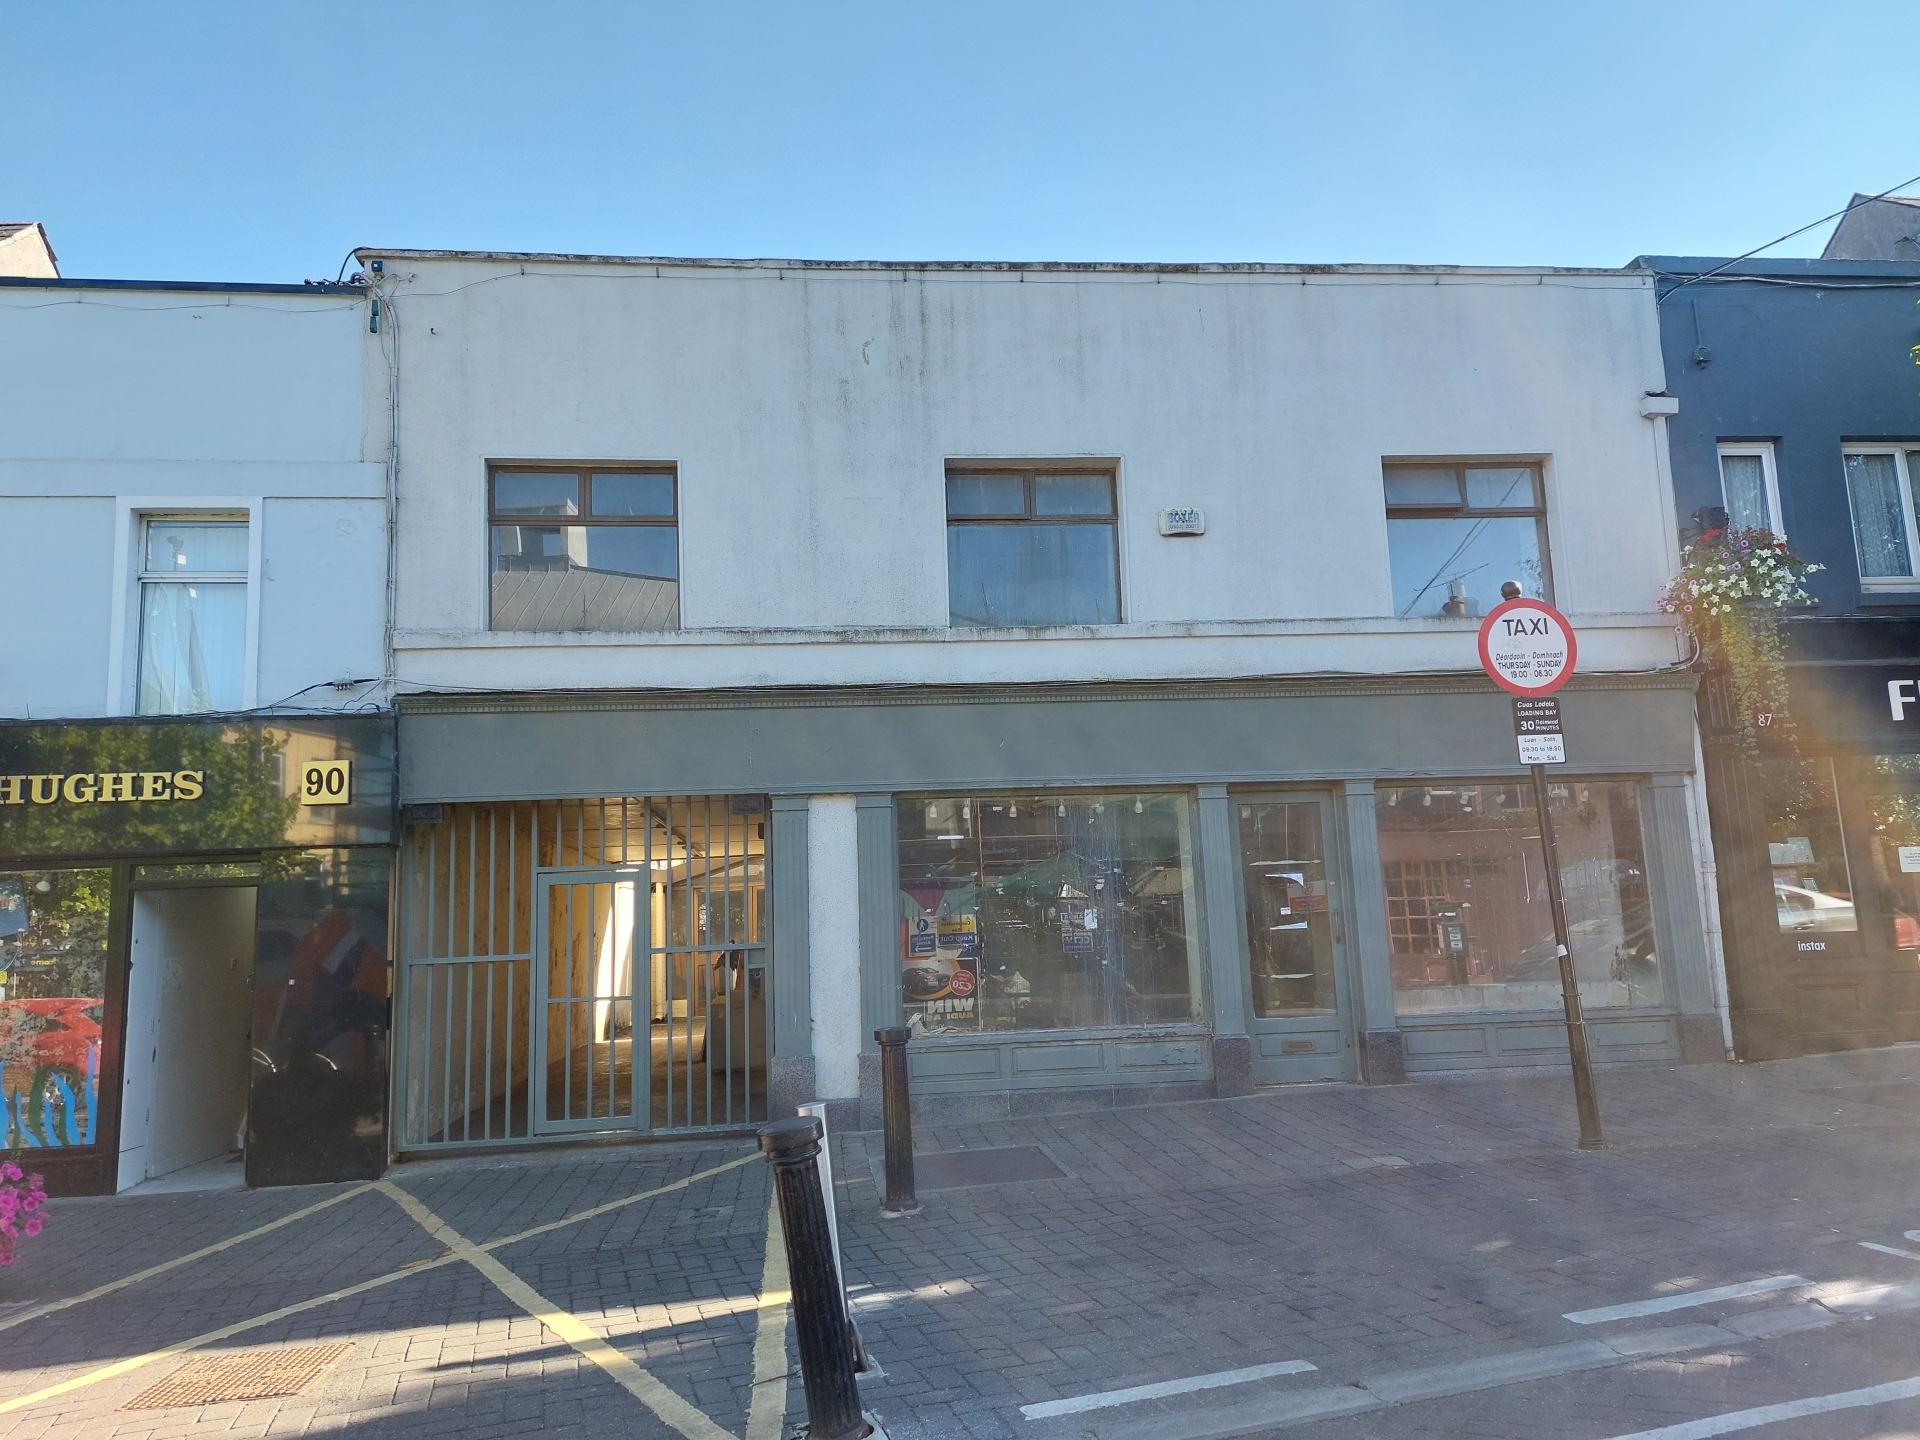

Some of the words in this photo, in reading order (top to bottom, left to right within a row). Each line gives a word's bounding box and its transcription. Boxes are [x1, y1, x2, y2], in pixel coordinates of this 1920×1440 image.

[1502, 617, 1549, 636] TAXI
[1497, 661, 1531, 670] THURSDAY
[1536, 660, 1562, 668] SUNDAY
[1520, 720, 1535, 731] 30
[1758, 713, 1772, 726] 87
[305, 767, 345, 796] 90
[1797, 940, 1826, 951] instax
